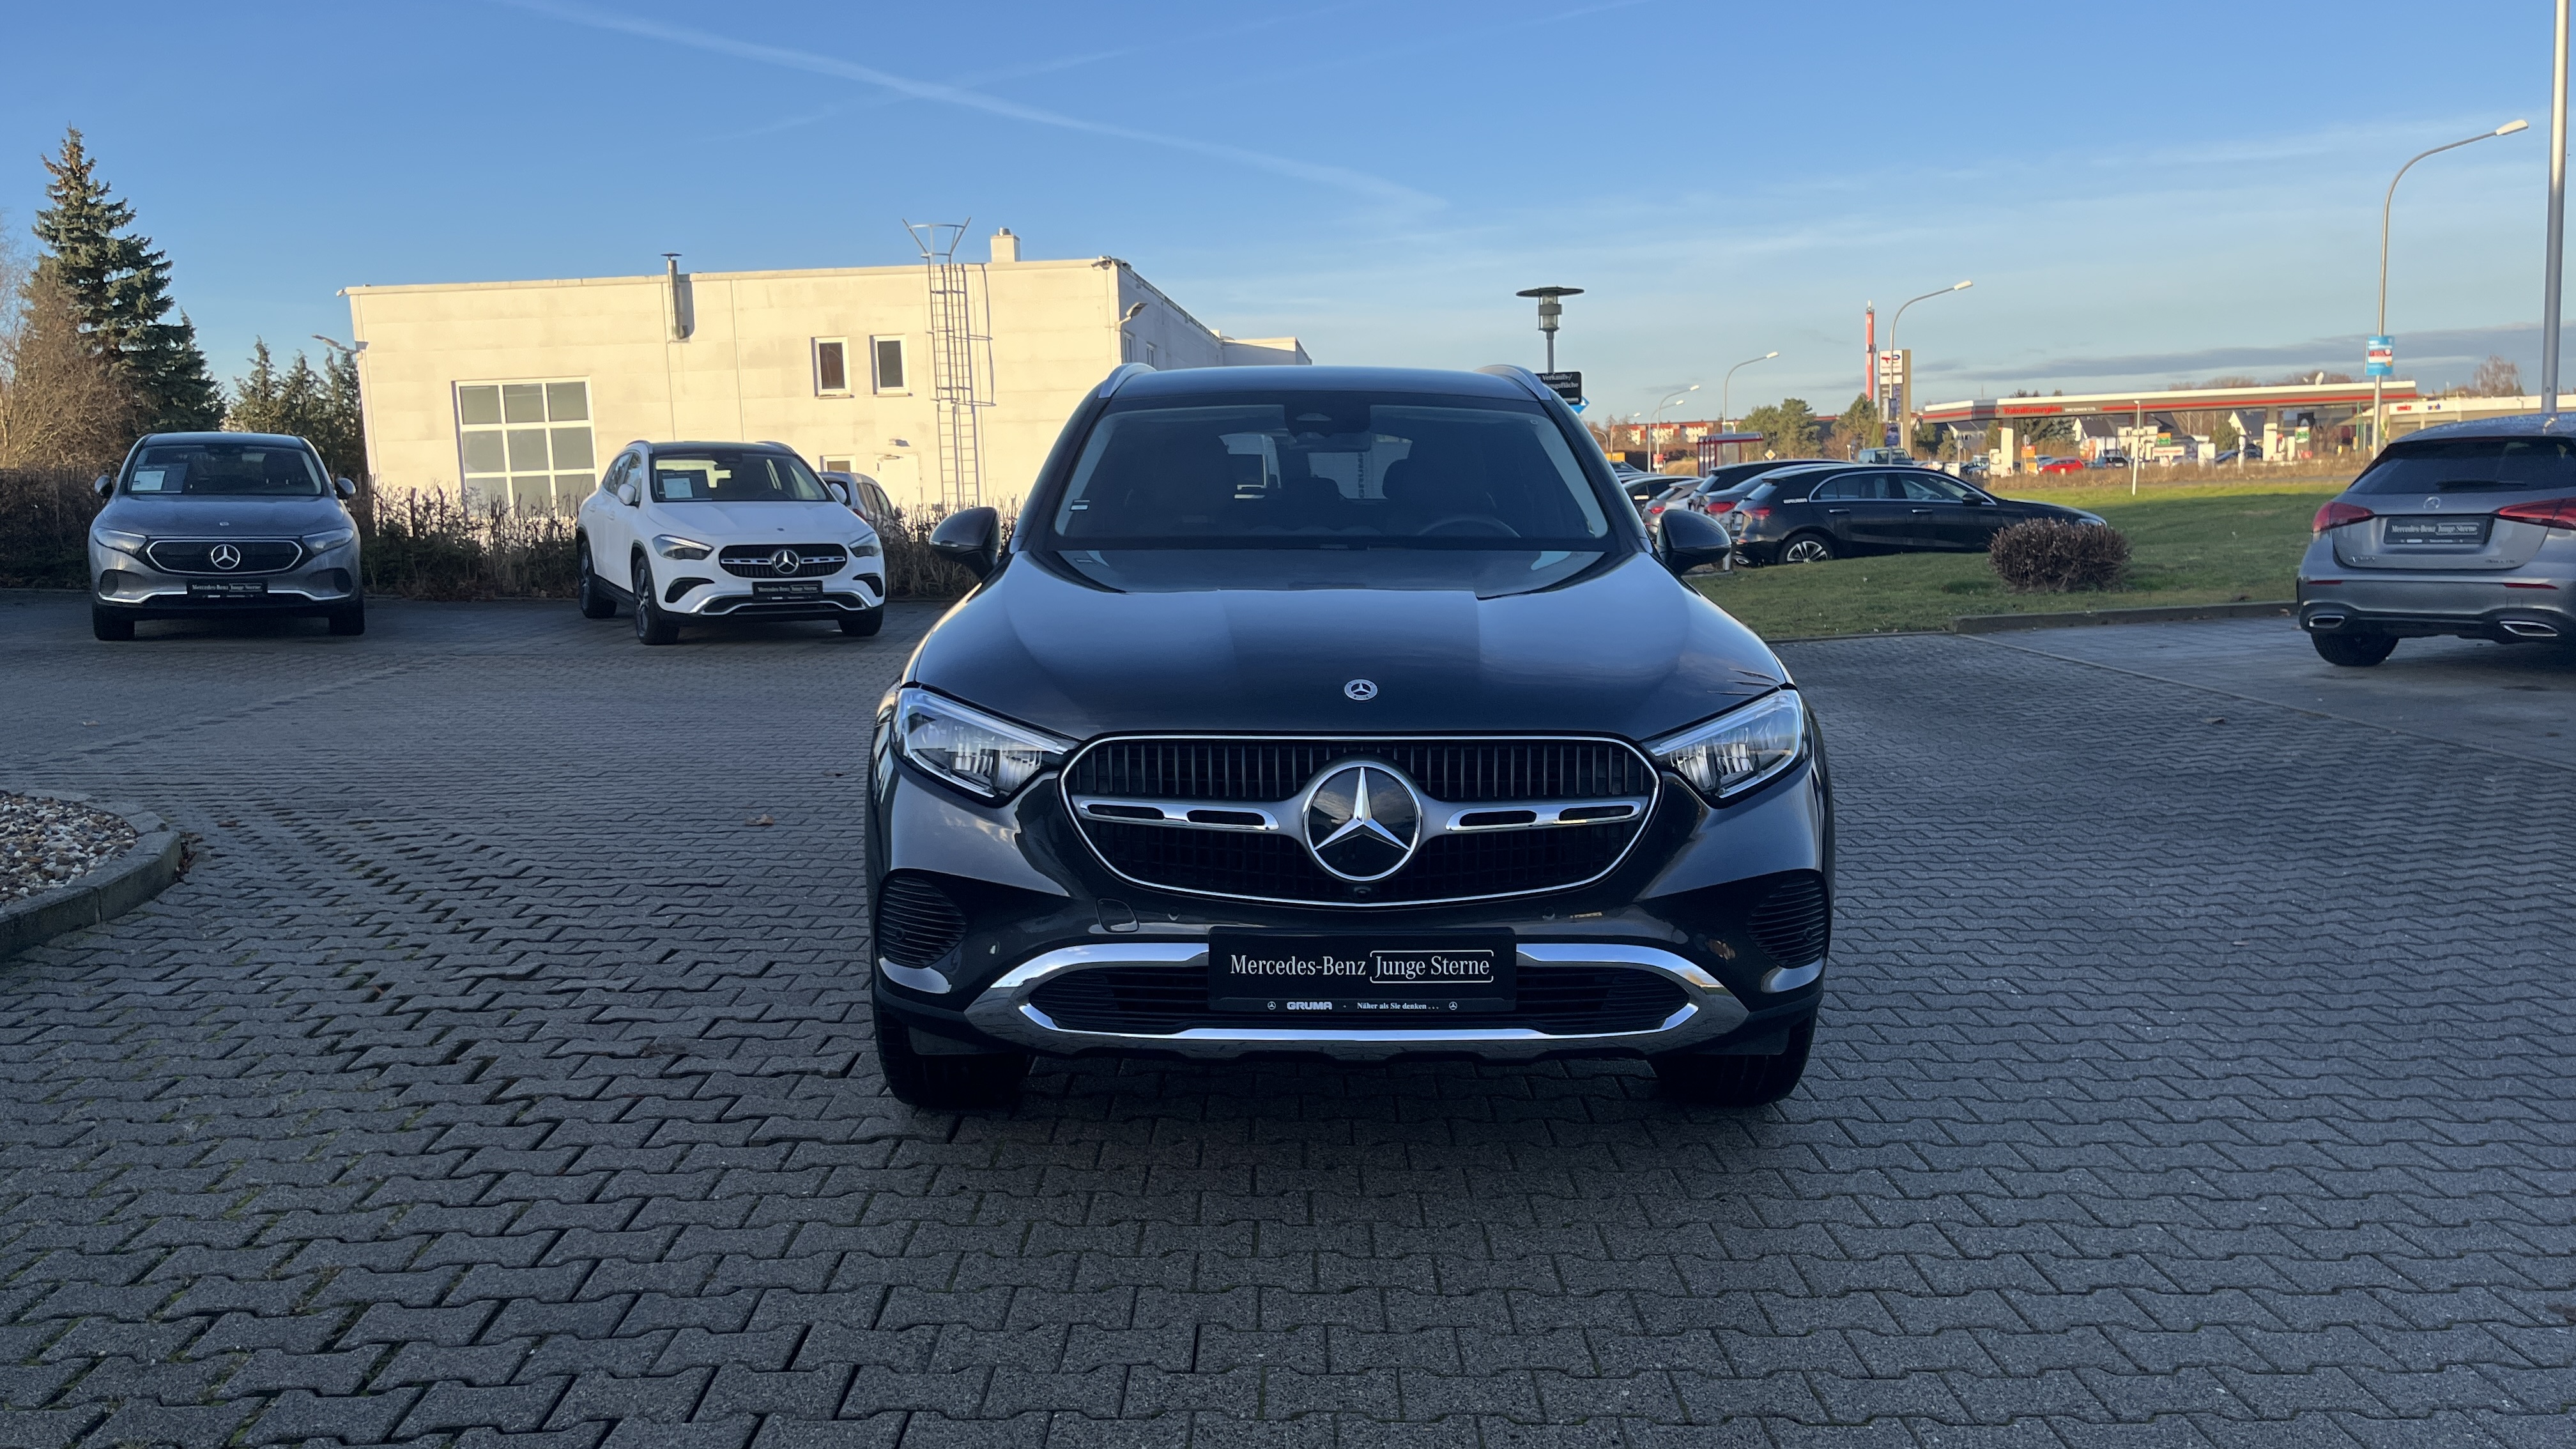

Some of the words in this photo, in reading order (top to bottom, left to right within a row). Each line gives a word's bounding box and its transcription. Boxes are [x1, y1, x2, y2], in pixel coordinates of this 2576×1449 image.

[1230, 954, 1366, 975] Mercedes-Benz
[1375, 956, 1425, 979] Junge
[1430, 955, 1490, 975] Sterne
[1287, 1001, 1332, 1010] GRUMA
